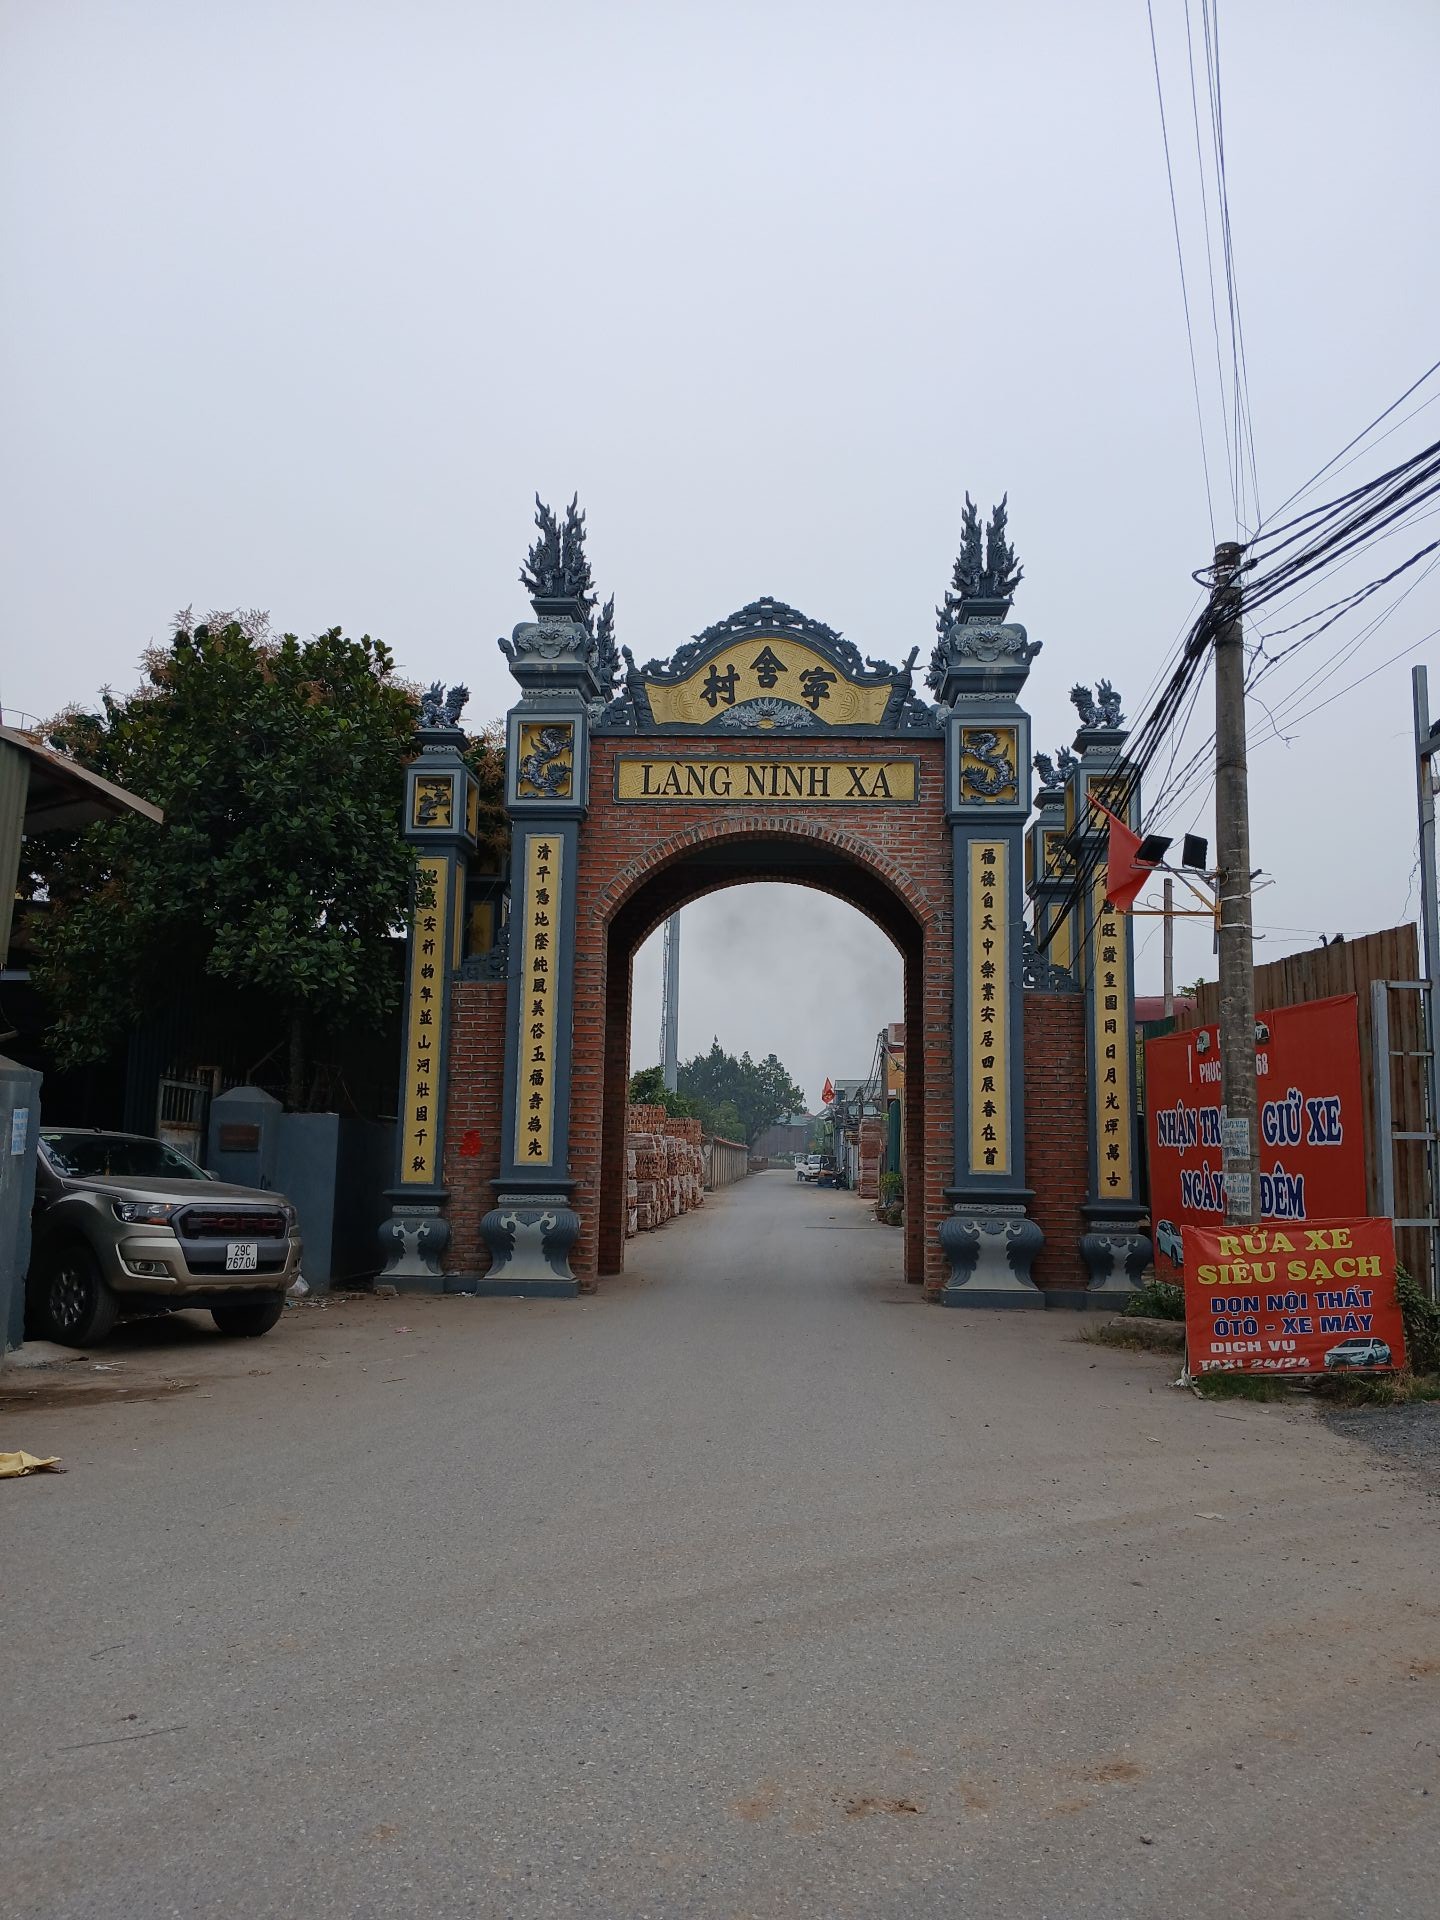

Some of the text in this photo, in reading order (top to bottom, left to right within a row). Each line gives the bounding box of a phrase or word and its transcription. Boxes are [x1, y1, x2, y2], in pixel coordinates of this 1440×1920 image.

[640, 761, 894, 798] LÀNG NINH XÁ
[1255, 1052, 1269, 1076] 68
[1156, 1098, 1198, 1157] NHẬN
[1261, 1086, 1303, 1147] GIỮ
[1305, 1094, 1344, 1146] XE
[1180, 1160, 1306, 1221] NGÀY ĐÊM
[234, 1244, 252, 1257] 29C
[1217, 1226, 1354, 1257] RỬA XE
[1197, 1255, 1383, 1286] SIÊU SẠCH
[1210, 1285, 1374, 1316] DỌN NỘI THẤT
[1213, 1315, 1259, 1337] ÔTÔ
[1281, 1316, 1314, 1335] XE
[1319, 1311, 1374, 1334] MÁY
[1210, 1339, 1297, 1354] DỊCH VỤ
[1199, 1356, 1312, 1371] TAXI 24/24
